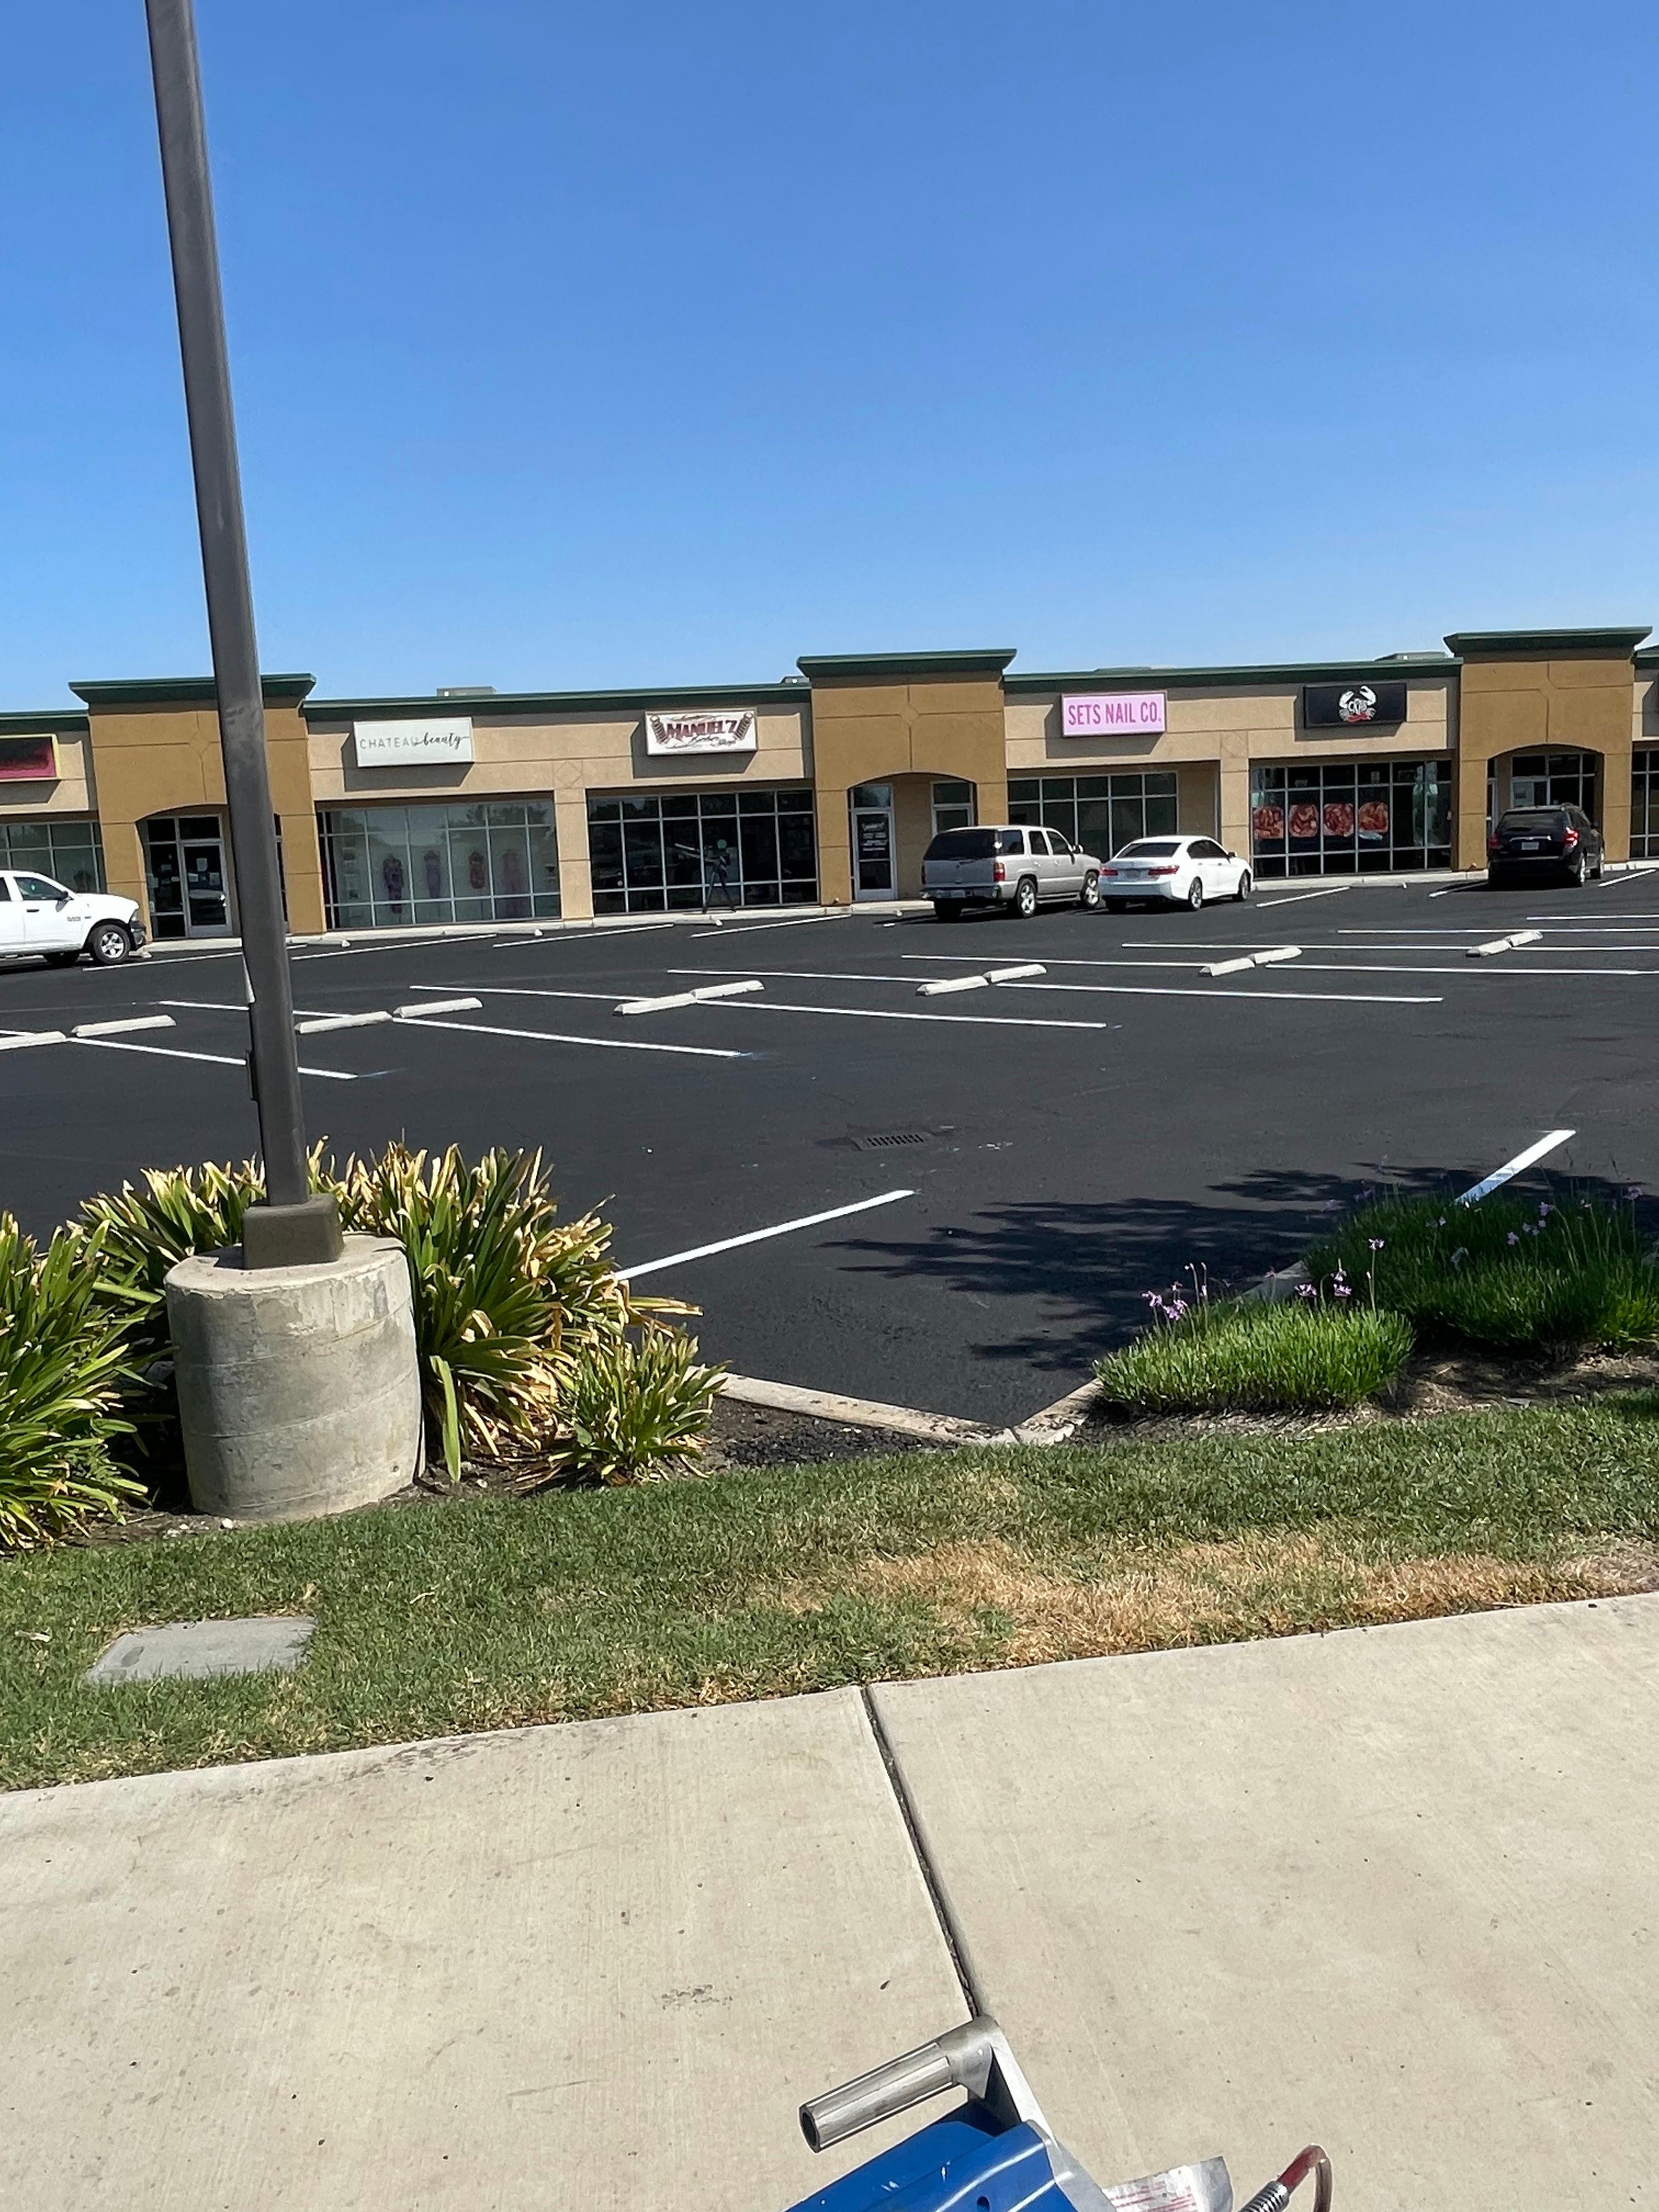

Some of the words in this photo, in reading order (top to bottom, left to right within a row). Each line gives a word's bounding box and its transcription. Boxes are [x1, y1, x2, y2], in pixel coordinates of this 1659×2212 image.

[1068, 704, 1101, 725] SETS
[1105, 703, 1136, 724] NAIL
[1141, 701, 1161, 723] CO.
[360, 737, 418, 749] CHATEAU
